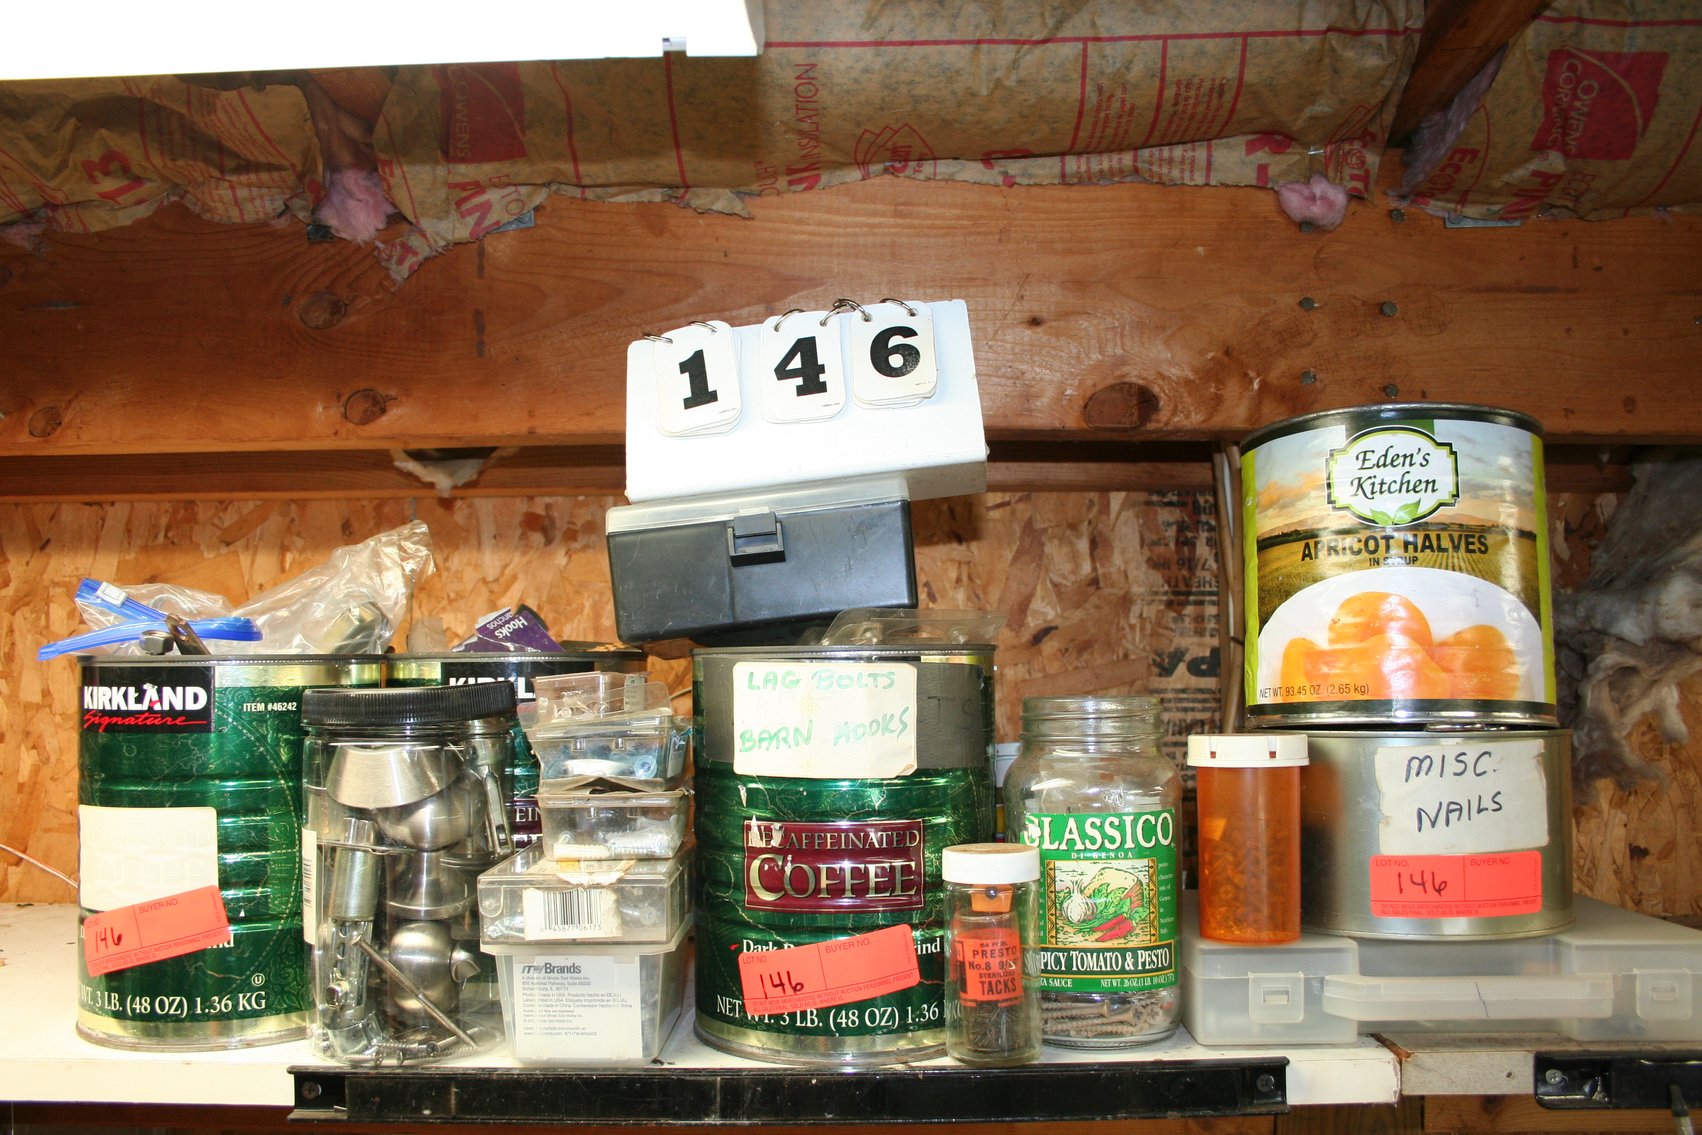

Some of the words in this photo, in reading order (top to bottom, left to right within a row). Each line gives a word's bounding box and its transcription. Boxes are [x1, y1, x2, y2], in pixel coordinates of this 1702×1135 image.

[1547, 57, 1582, 150] CORNING
[1565, 79, 1600, 154] OWENS
[678, 349, 718, 410] 1
[773, 335, 828, 397] 4
[869, 326, 922, 378] 6
[1355, 445, 1431, 470] Eden's
[1350, 471, 1439, 500] Kitchen
[1300, 535, 1398, 561] APRICOT
[1402, 533, 1489, 554] HALVES
[1369, 557, 1380, 566] IN
[494, 616, 528, 639] Hooks
[747, 670, 802, 691] LAG
[811, 668, 896, 690] BOLTS
[1259, 687, 1271, 698] NET
[1272, 687, 1284, 698] WT.
[1285, 684, 1307, 697] 93.45
[1308, 684, 1324, 695] OZ.
[1326, 683, 1351, 696] (2.65
[1353, 683, 1369, 695] kg)
[83, 683, 208, 711] KIRKLAND
[243, 702, 265, 712] ITEM
[267, 702, 298, 711] #46242
[83, 711, 208, 733] Signature
[739, 719, 813, 753] BARN
[1405, 751, 1497, 783] MISC.
[1416, 791, 1503, 833] NAILS
[1023, 812, 1174, 851] CLASSICO
[1092, 851, 1133, 859] GENOA
[1375, 859, 1393, 867] LOT
[1470, 858, 1498, 867] BUYER
[750, 853, 917, 901] COFFEE
[1397, 870, 1448, 896] 146
[139, 901, 163, 914] BUYER
[95, 926, 123, 954] 146
[577, 924, 602, 932] 06173
[742, 939, 777, 953] Dark
[825, 940, 855, 954] BUYER
[856, 936, 872, 947] NO.
[973, 945, 1017, 959] PRESTO
[743, 956, 755, 964] LOT
[756, 955, 768, 964] NO.
[1070, 950, 1122, 971] TOMATO
[1124, 951, 1135, 970] &
[1137, 947, 1170, 970] PESTO
[759, 969, 804, 999] 146
[979, 977, 1017, 996] TACKS
[1048, 978, 1073, 987] SAUCE
[95, 991, 102, 1008] 3
[104, 991, 123, 1011] LB.
[127, 994, 151, 1015] (48
[155, 995, 188, 1018] OZ)
[194, 995, 232, 1014] 1.36
[238, 991, 267, 1011] KG
[716, 994, 744, 1018] NET
[780, 1008, 790, 1025] 3
[795, 1006, 823, 1028] LB.
[829, 1007, 859, 1031] (48
[865, 1005, 899, 1030] OZ)
[906, 1001, 939, 1024] 1.36
